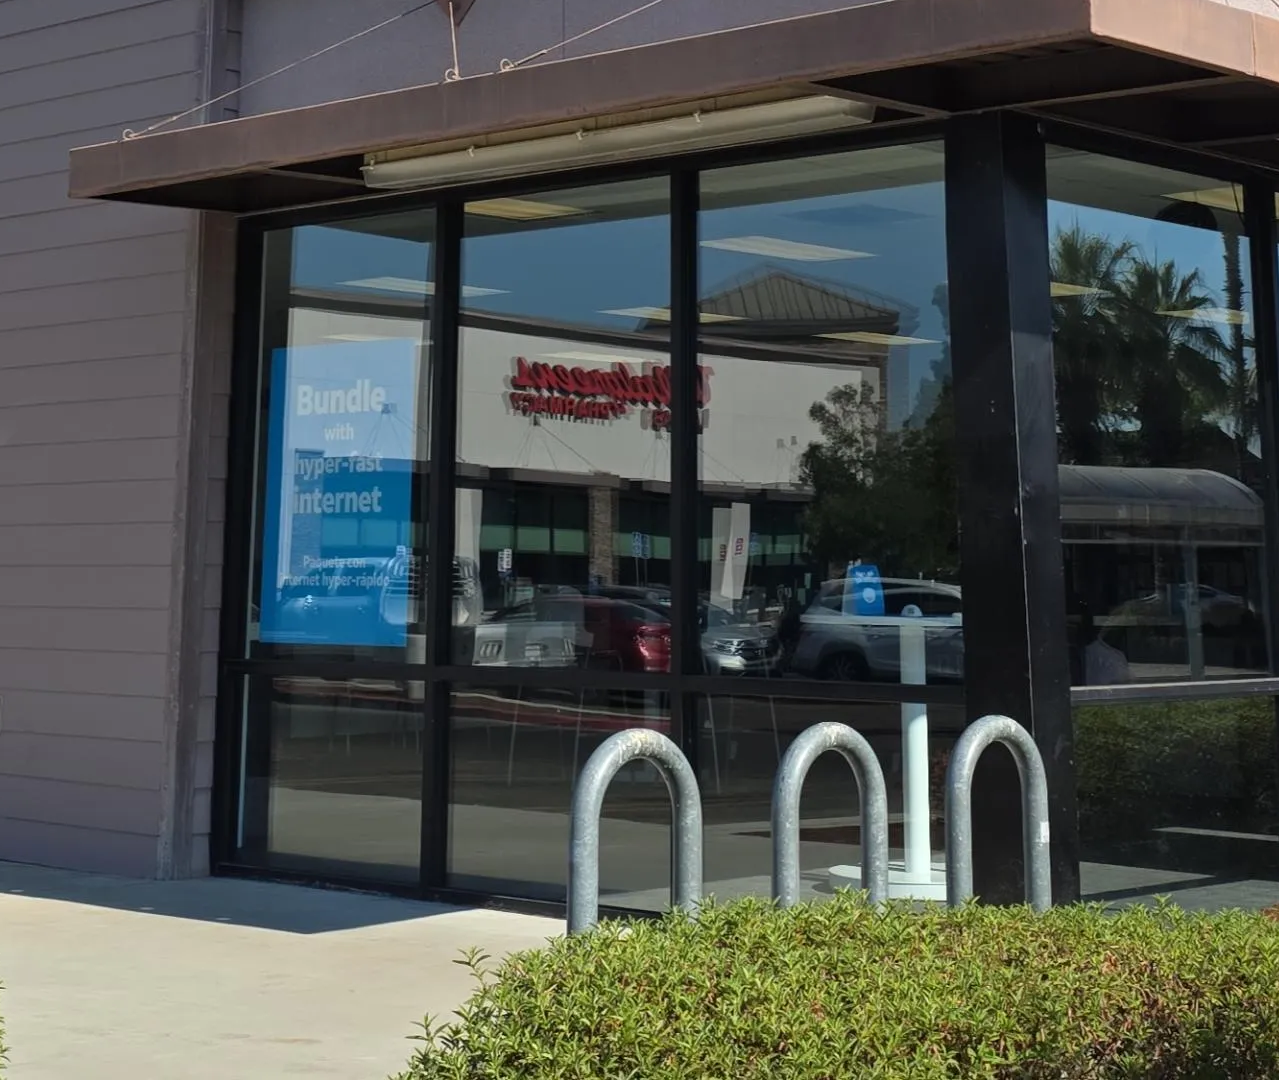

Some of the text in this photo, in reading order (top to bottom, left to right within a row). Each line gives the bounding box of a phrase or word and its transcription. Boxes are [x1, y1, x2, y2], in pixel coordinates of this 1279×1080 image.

[296, 379, 386, 417] Bundle
[324, 424, 354, 441] with
[294, 450, 383, 480] hyper-fast
[293, 486, 382, 514] internet
[303, 555, 367, 571] Paquete con
